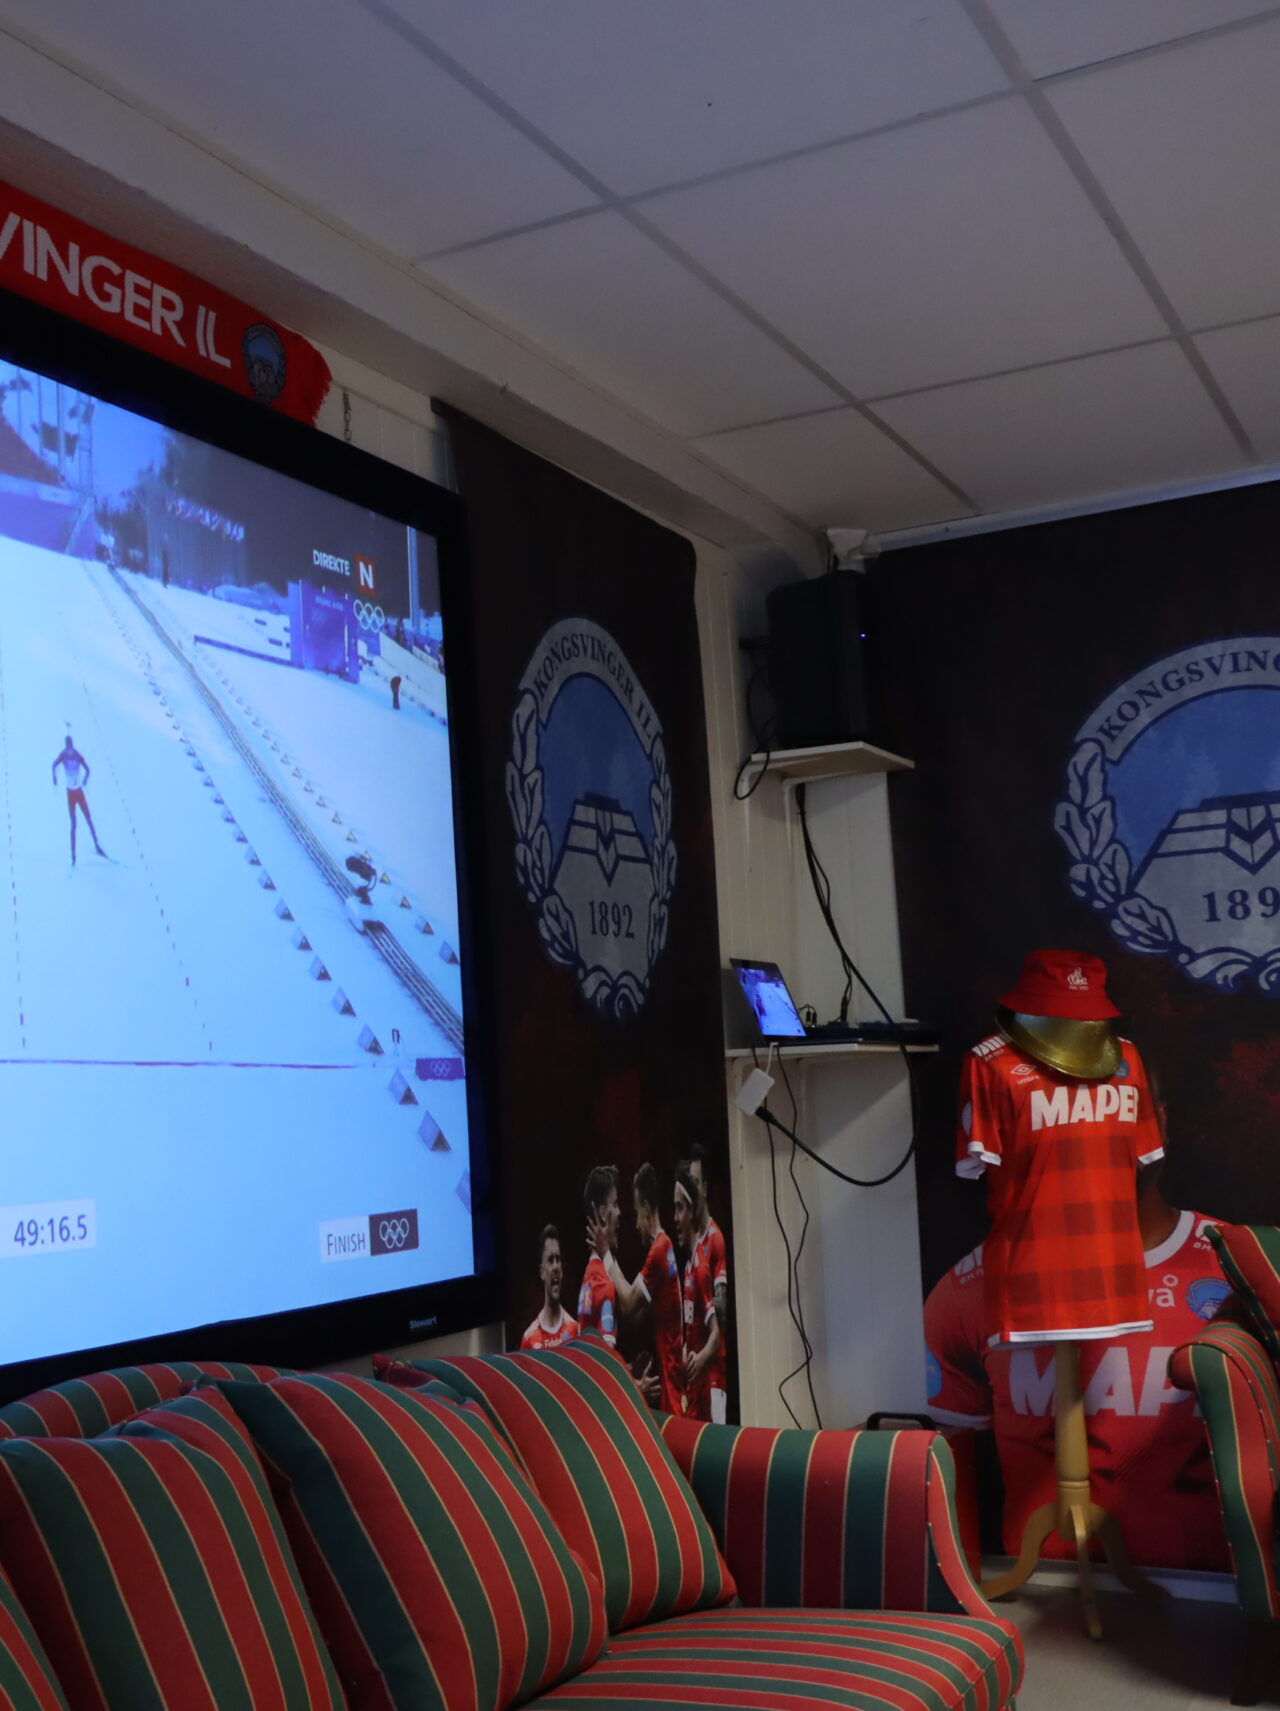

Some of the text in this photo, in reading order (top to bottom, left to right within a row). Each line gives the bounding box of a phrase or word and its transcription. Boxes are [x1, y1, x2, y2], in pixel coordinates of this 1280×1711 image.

[196, 304, 232, 370] IL
[312, 549, 374, 590] DIREKTE N
[533, 633, 654, 740] KONGSVINGER IL
[1097, 650, 1280, 743] KONGSVIN
[589, 900, 635, 939] 1892
[13, 1214, 88, 1248] 49:16.5
[1009, 1345, 1202, 1417] MAP
